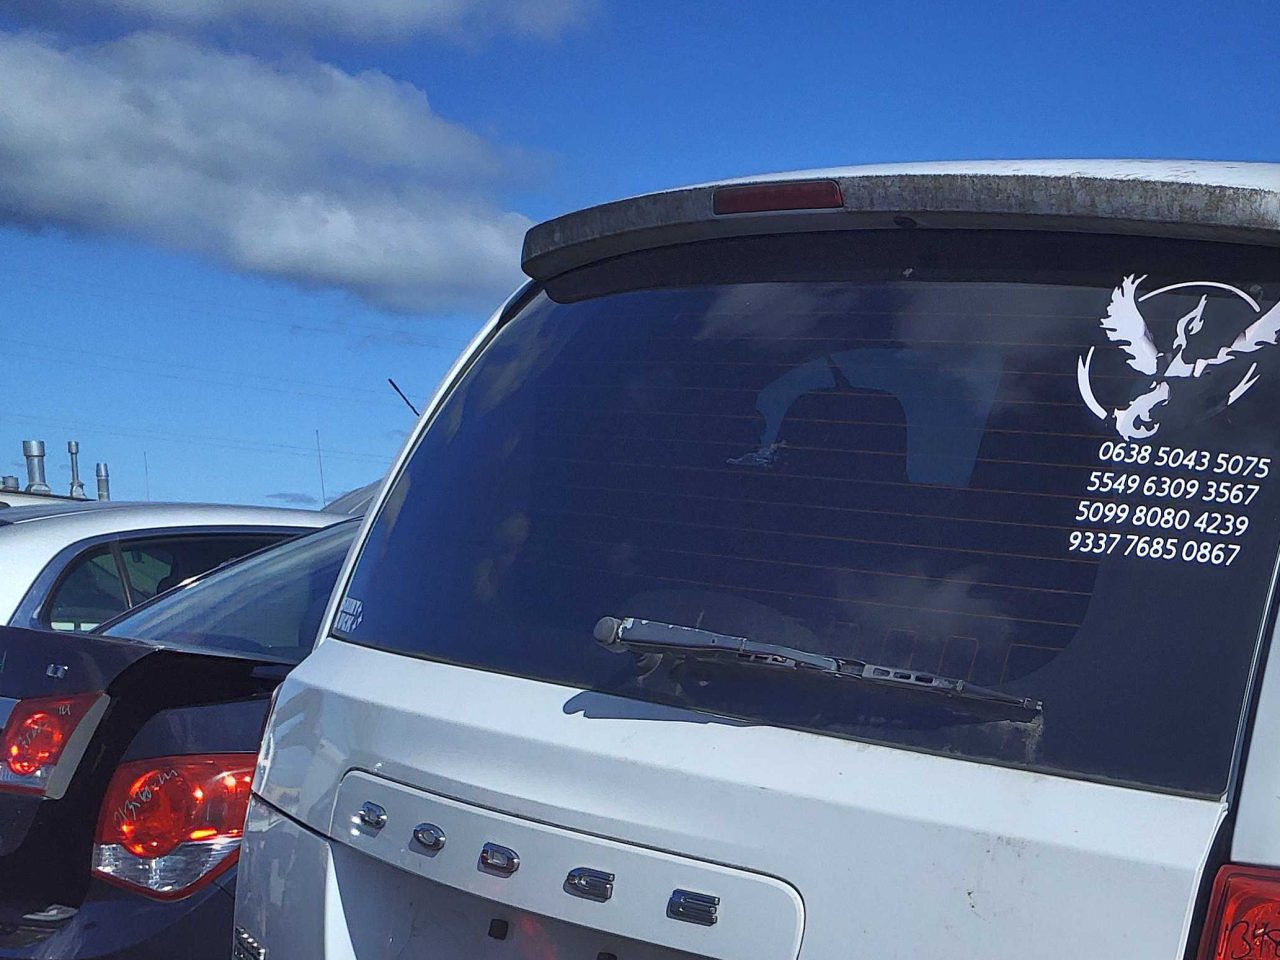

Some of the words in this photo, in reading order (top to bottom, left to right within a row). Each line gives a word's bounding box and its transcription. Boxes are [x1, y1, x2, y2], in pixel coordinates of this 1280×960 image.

[1098, 441, 1152, 465] 0638
[1154, 446, 1211, 471] 5043
[1213, 453, 1271, 479] 5075
[1086, 471, 1141, 494] 5549
[1143, 476, 1200, 499] 6309
[1201, 481, 1260, 505] 3567
[1075, 500, 1130, 524] 5099
[1132, 505, 1191, 530] 8080
[1193, 511, 1249, 537] 4239
[1068, 531, 1122, 555] 9337
[1123, 534, 1178, 560] 7685
[1181, 540, 1241, 566] 0867
[358, 800, 721, 926] DODGE
